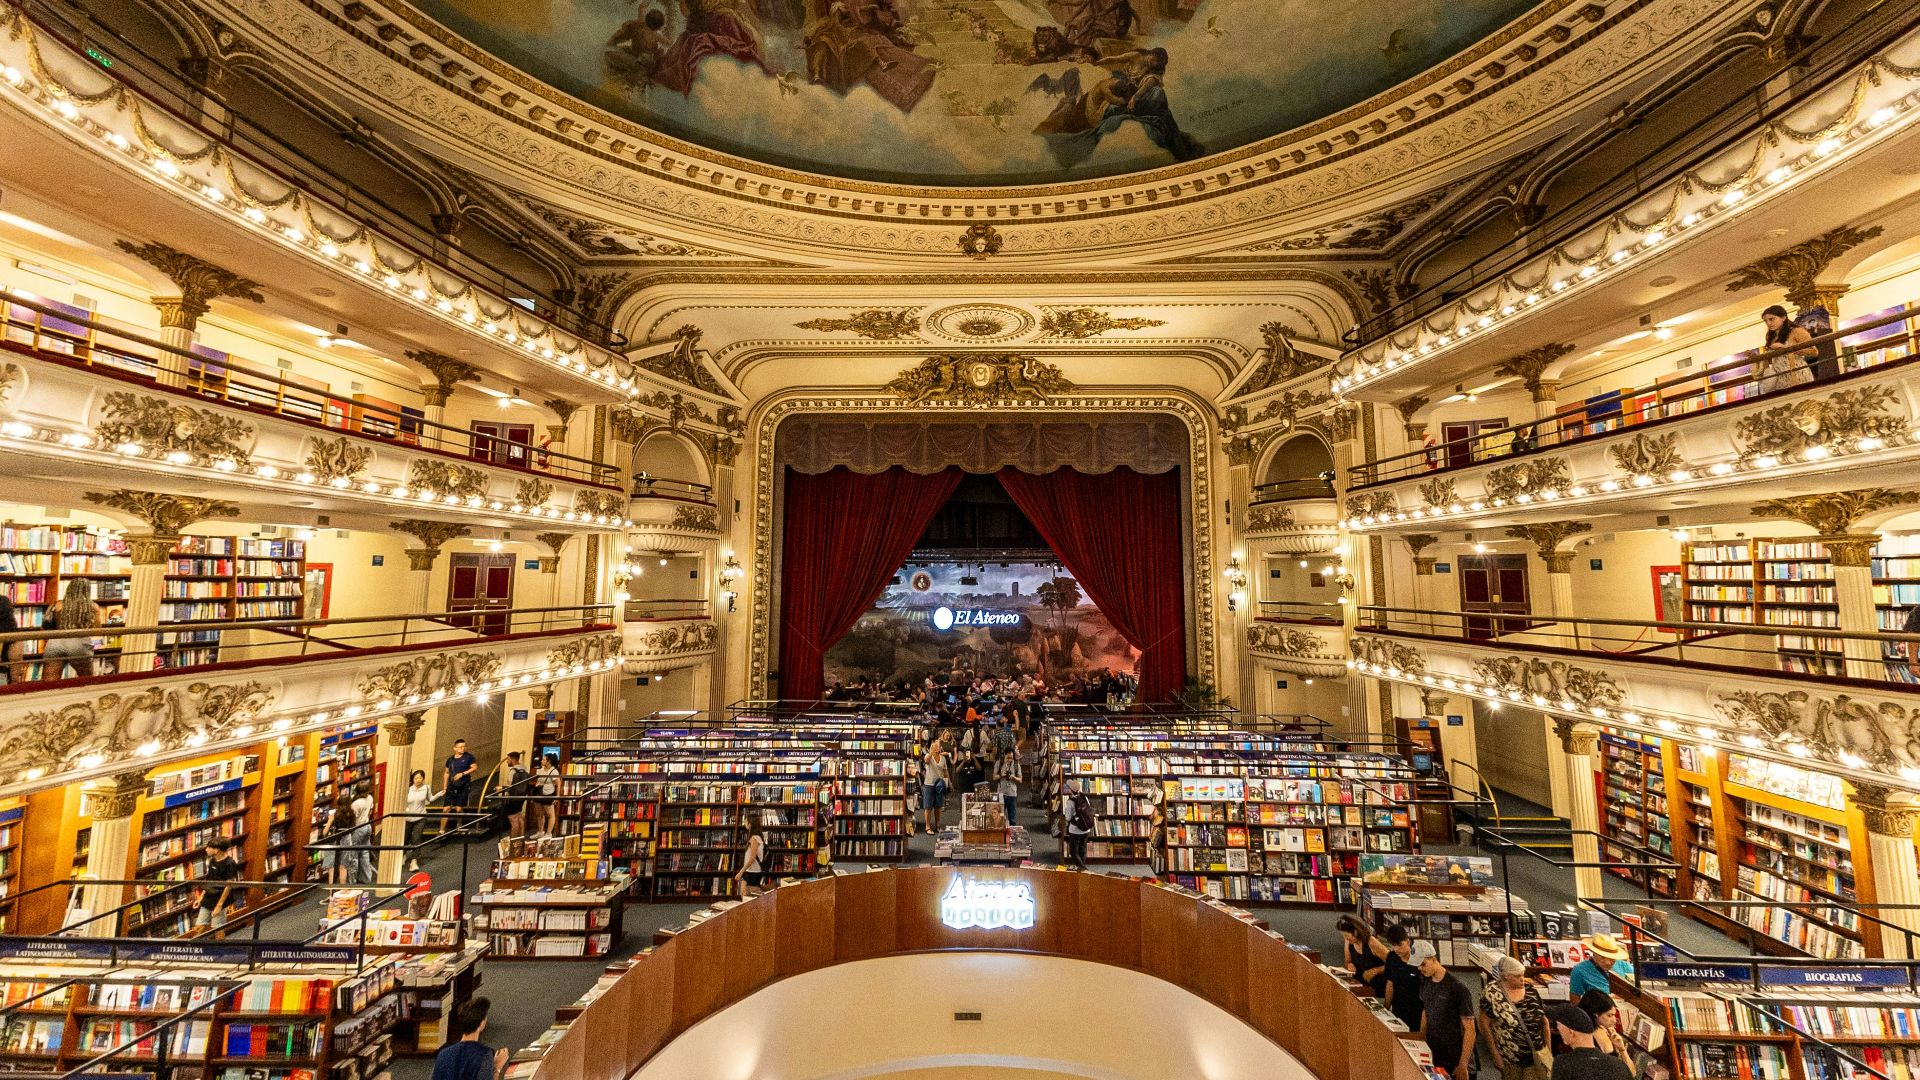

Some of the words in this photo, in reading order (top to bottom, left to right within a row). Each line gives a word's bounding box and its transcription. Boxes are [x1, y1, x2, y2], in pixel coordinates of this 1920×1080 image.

[953, 610, 971, 625] El
[972, 609, 1020, 625] Ateneo
[26, 942, 67, 950] LITERATURA
[162, 946, 203, 954] LITERATURA
[15, 950, 77, 958] LATINOAMERICANA
[150, 953, 214, 962] LATINOAMERICANA
[261, 950, 297, 959] LITERATURA
[296, 951, 349, 960] LATINOAMERICANA
[1667, 967, 1725, 978] BIOGRAFÍAS
[1804, 972, 1863, 982] BIOGRAFIAS
